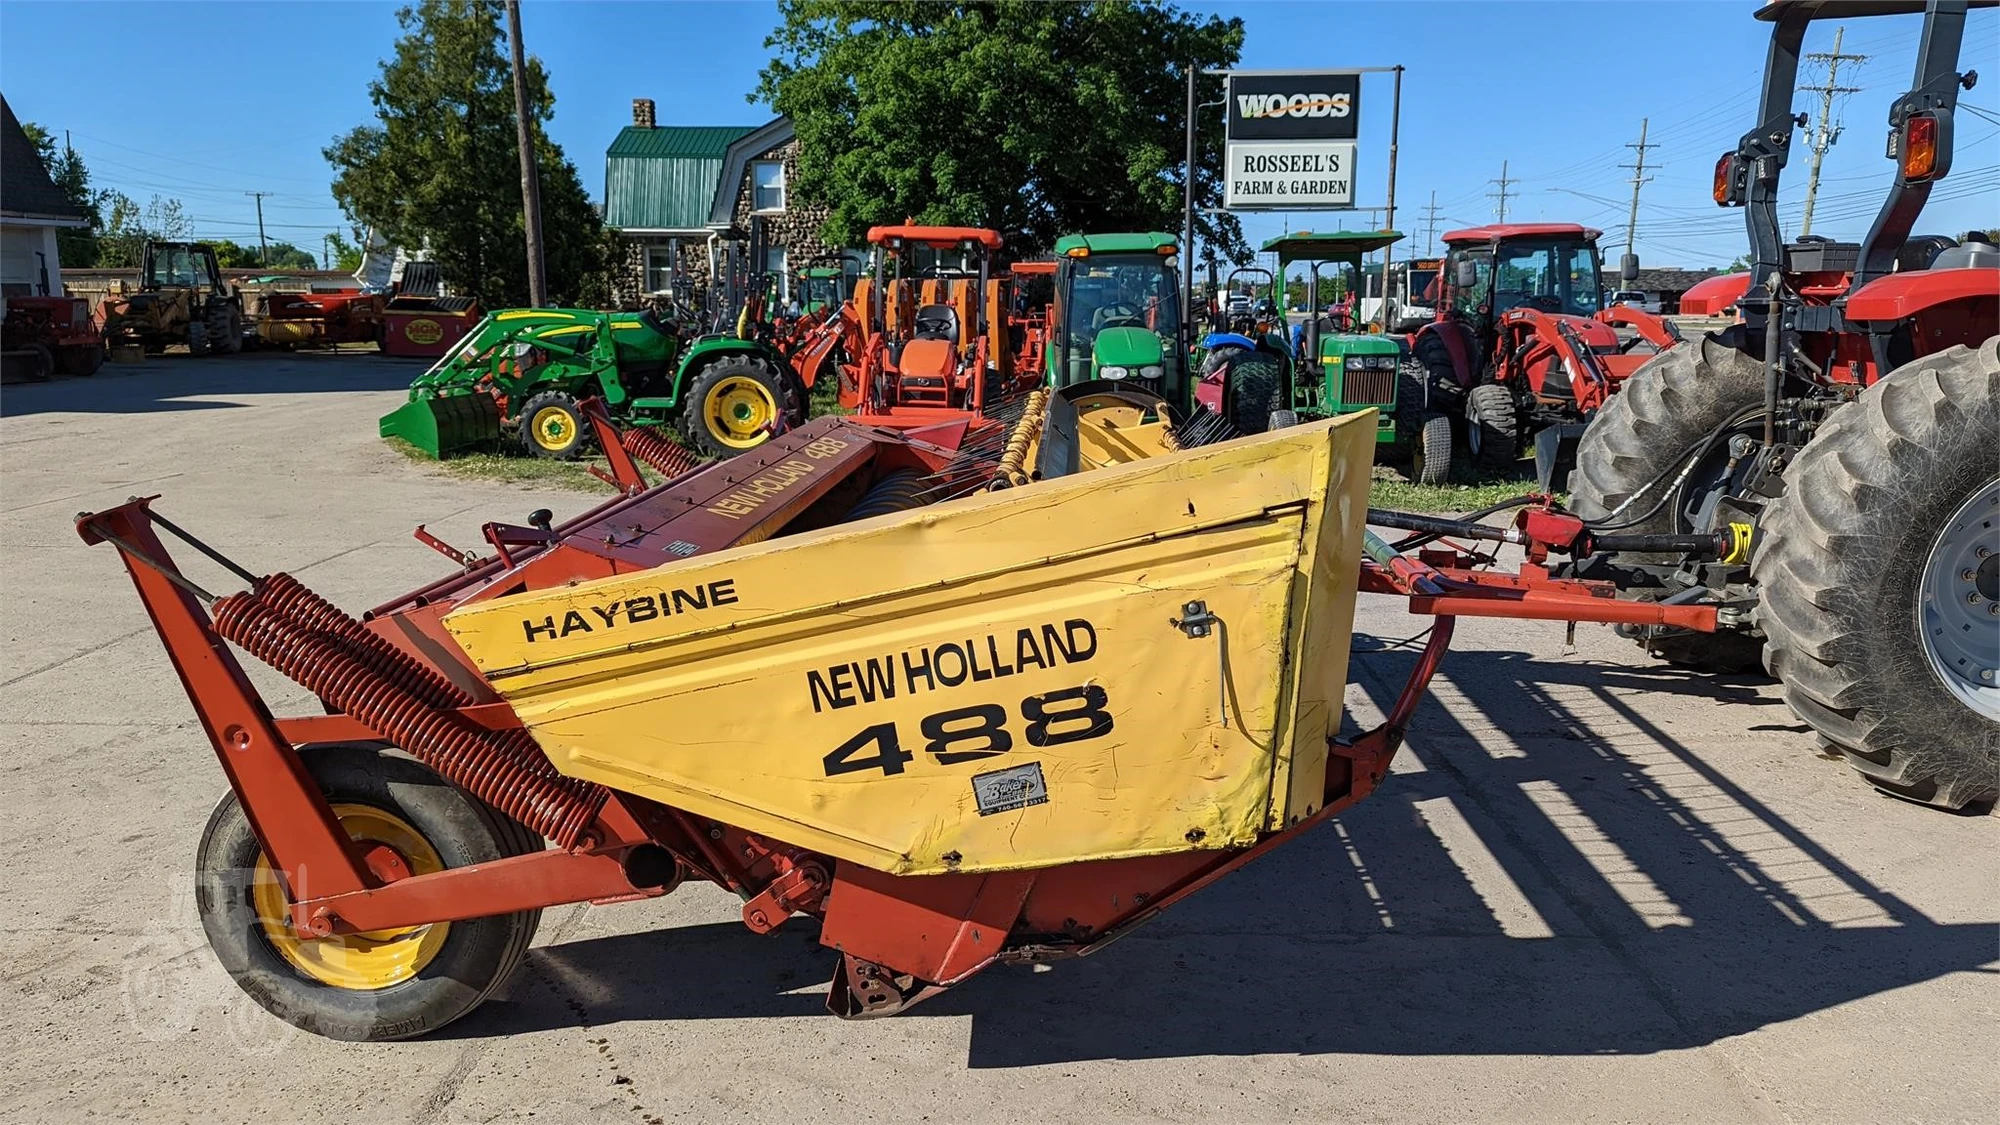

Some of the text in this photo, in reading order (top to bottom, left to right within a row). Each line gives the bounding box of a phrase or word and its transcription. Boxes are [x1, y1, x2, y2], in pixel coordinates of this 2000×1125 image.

[1237, 93, 1350, 118] WOODS
[1243, 154, 1340, 173] ROSSEEL'S
[1234, 180, 1348, 195] FARM & GARDEN
[706, 436, 849, 520] NEW HOLLAND 488
[522, 578, 740, 642] HAYBINE
[806, 618, 1098, 713] NEW HOLLAND
[821, 685, 1115, 777] 488
[997, 797, 1046, 812] 740-563317
